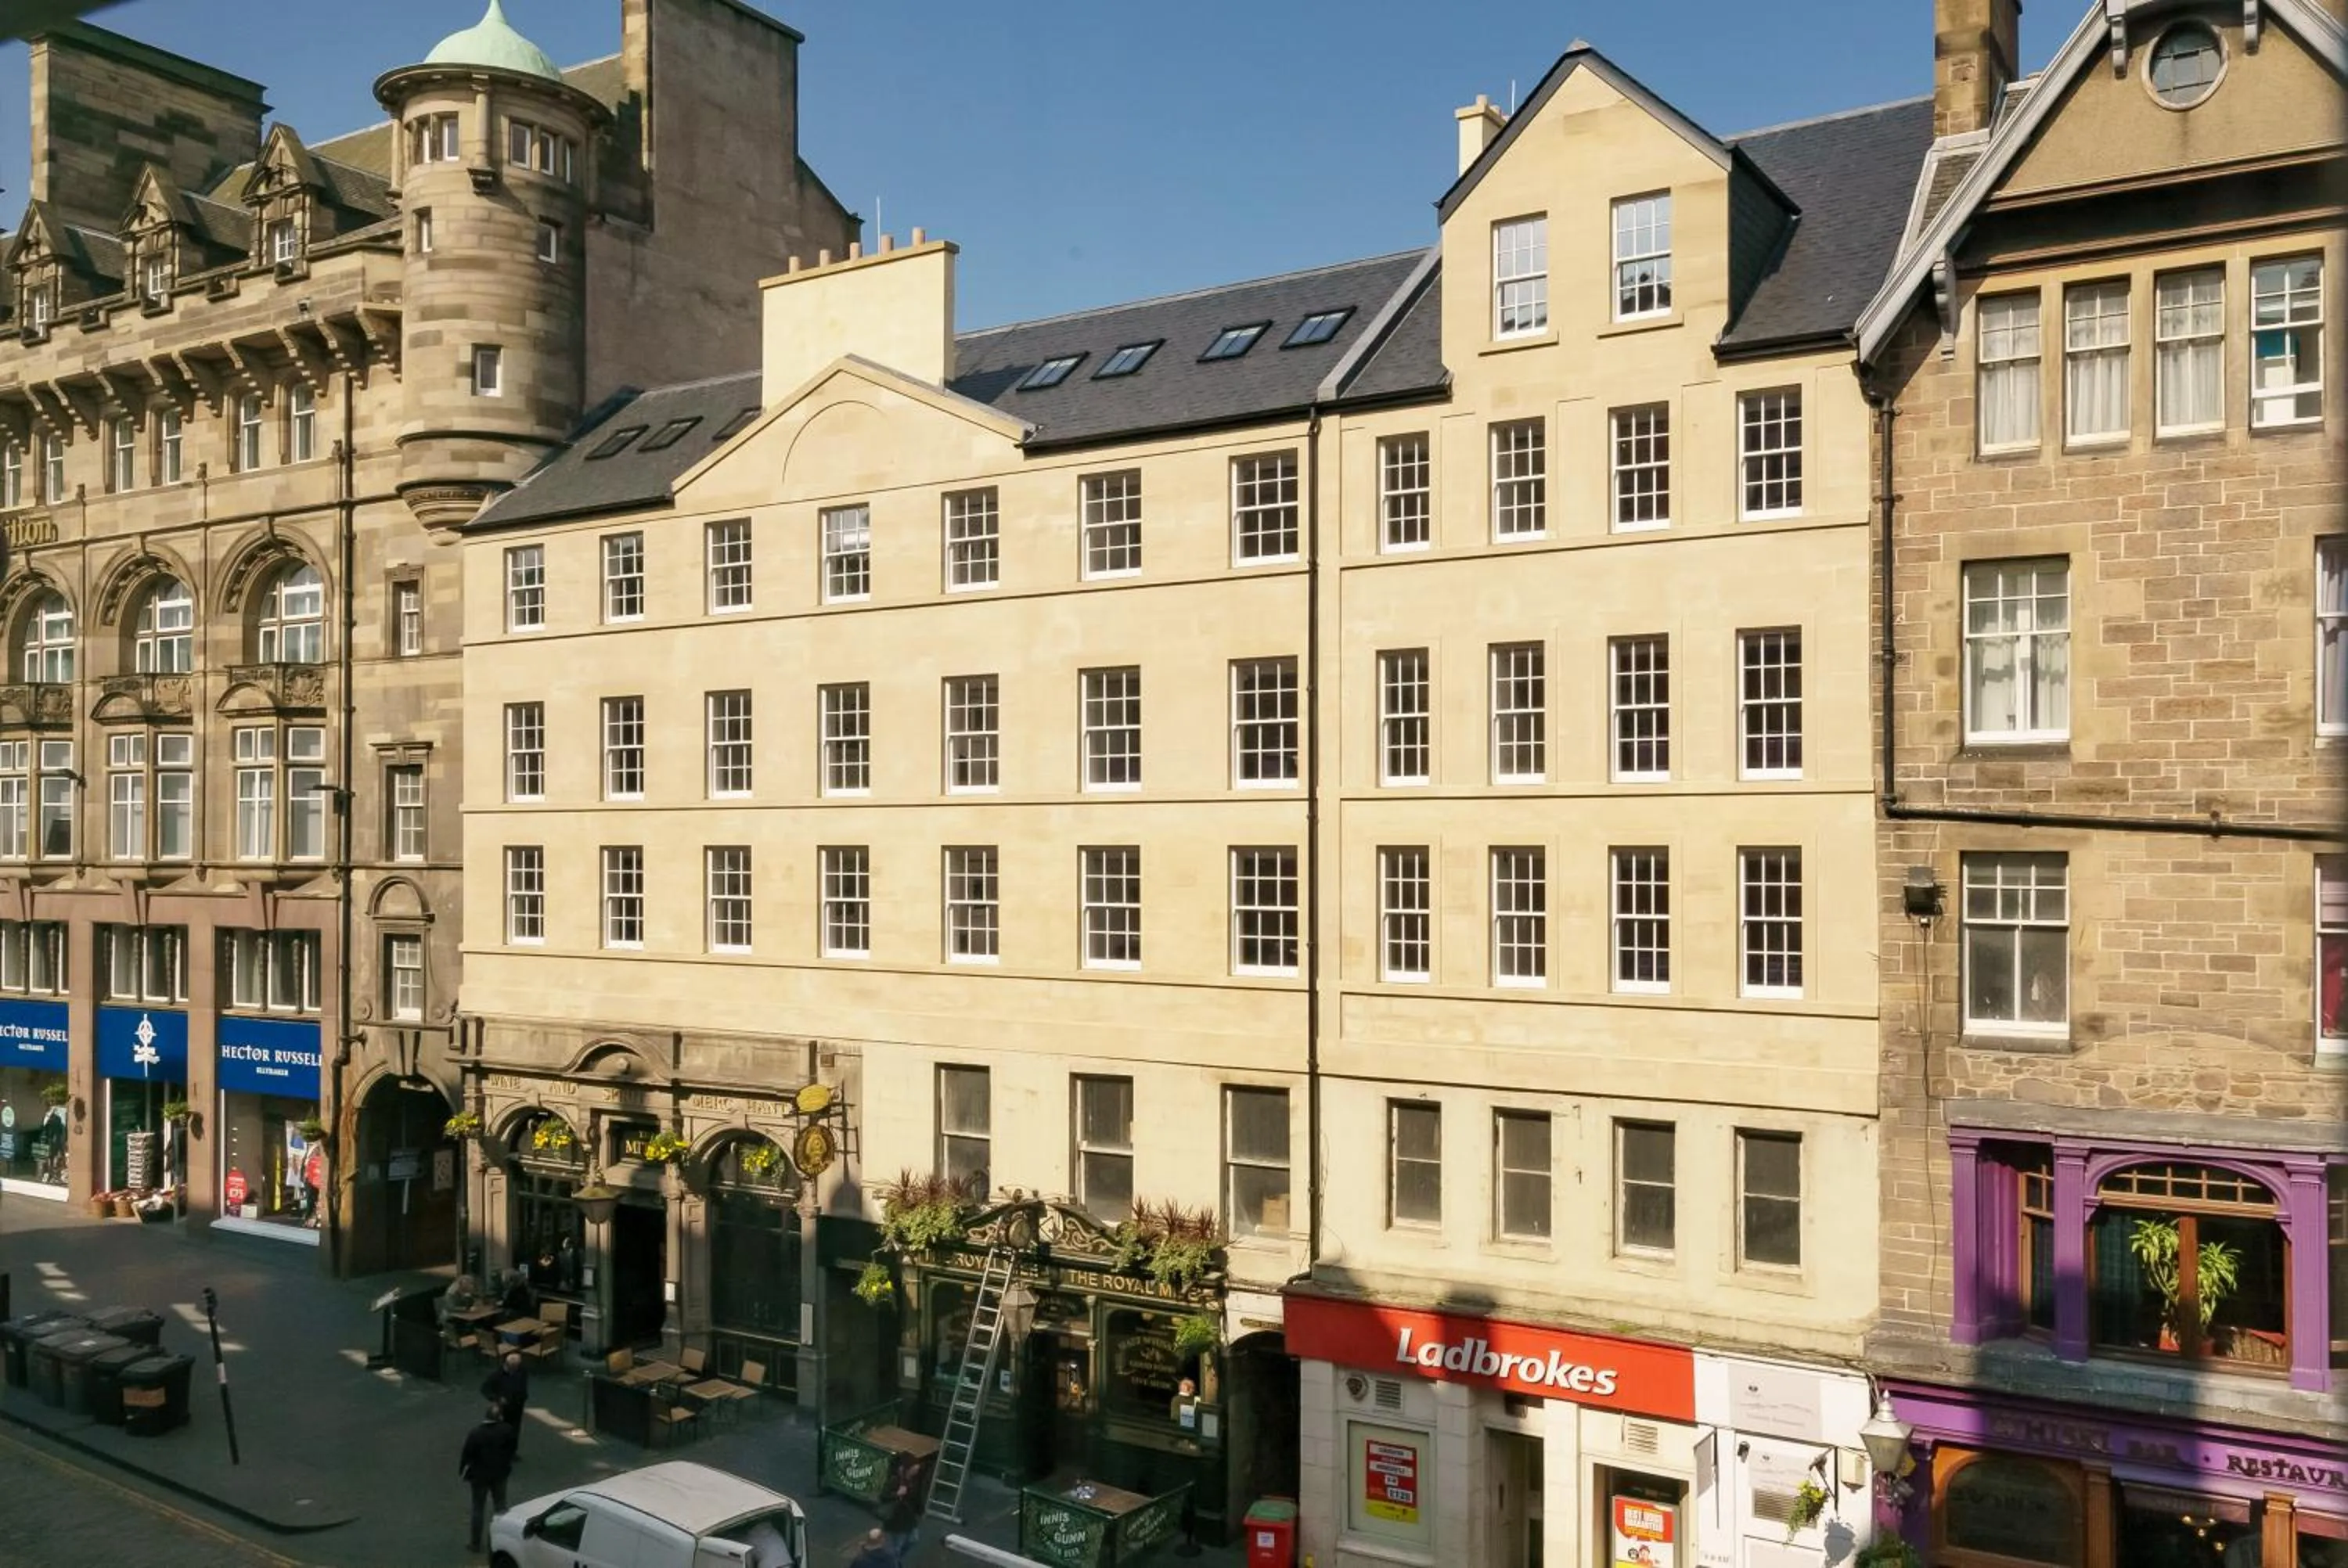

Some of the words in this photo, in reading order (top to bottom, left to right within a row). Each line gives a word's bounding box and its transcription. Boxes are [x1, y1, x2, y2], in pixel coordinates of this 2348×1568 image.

[221, 1045, 270, 1062] HECTOR
[488, 1074, 520, 1089] WINE
[549, 1081, 579, 1095] AND
[1069, 1270, 1098, 1286] THE
[1103, 1275, 1155, 1295] ROYAL
[1396, 1327, 1619, 1396] Ladbrokes
[2226, 1455, 2348, 1487] RESTAUR
[1039, 1511, 1071, 1525] INNIS
[1053, 1530, 1086, 1545] GUNN
